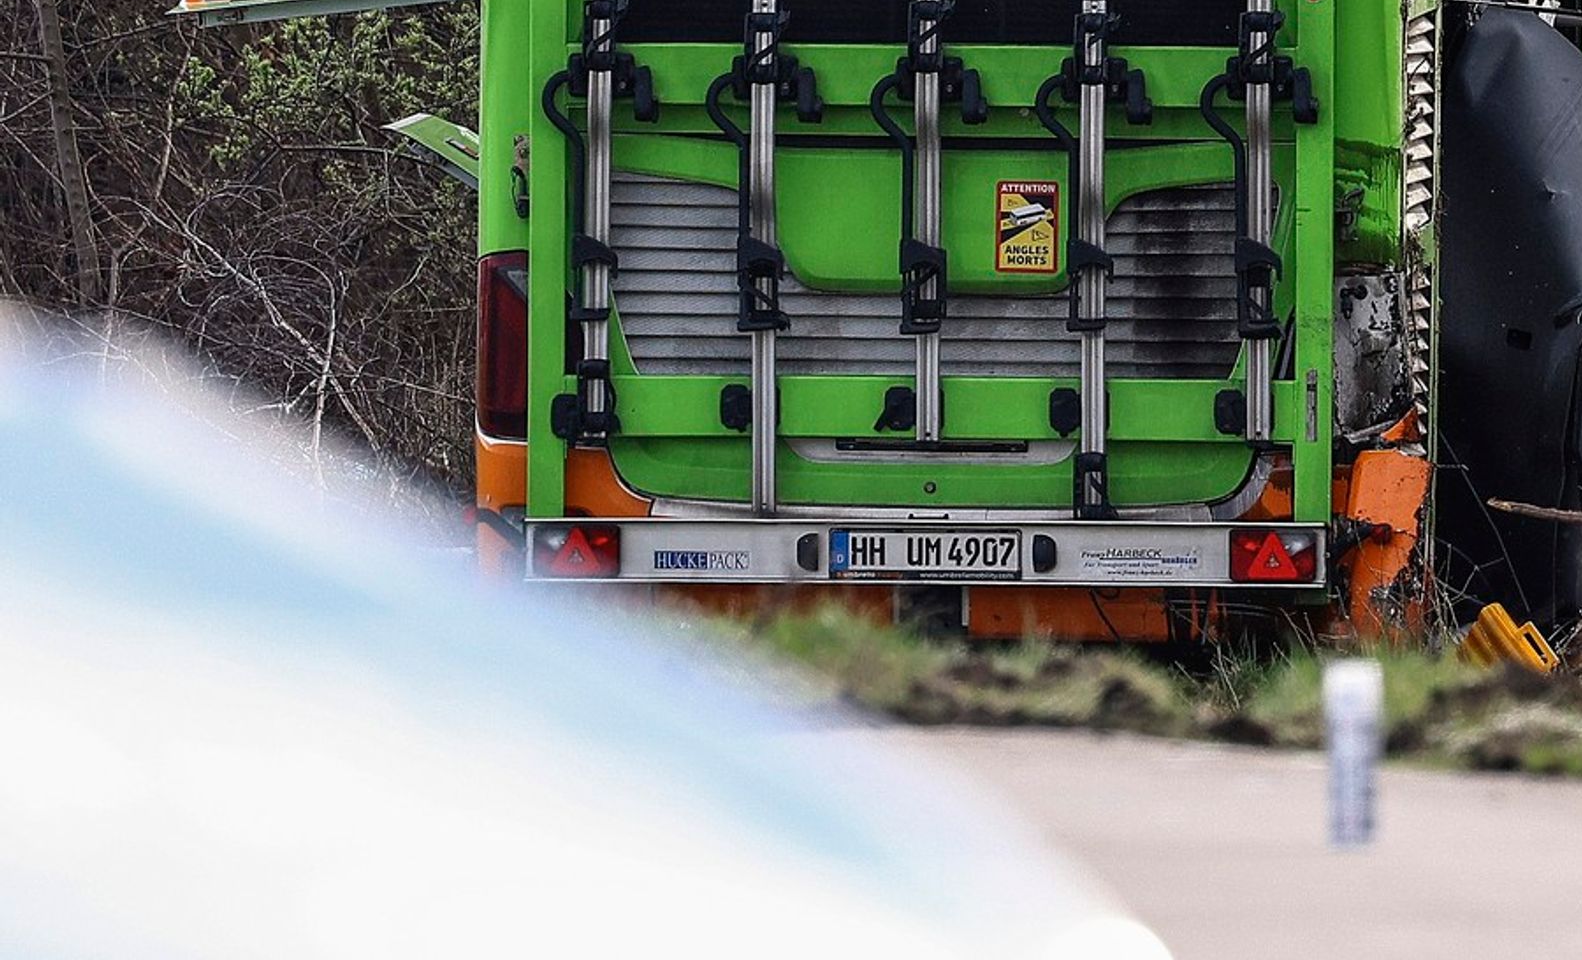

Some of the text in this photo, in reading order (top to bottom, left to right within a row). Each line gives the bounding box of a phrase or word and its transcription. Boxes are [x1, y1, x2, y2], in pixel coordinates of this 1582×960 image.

[1001, 184, 1055, 192] ATTENTION
[1005, 246, 1048, 254] ANGLES
[1007, 256, 1046, 264] MORTS
[851, 537, 1015, 566] HH UM 4907
[1105, 548, 1162, 557] HARBECK
[837, 554, 844, 563] D
